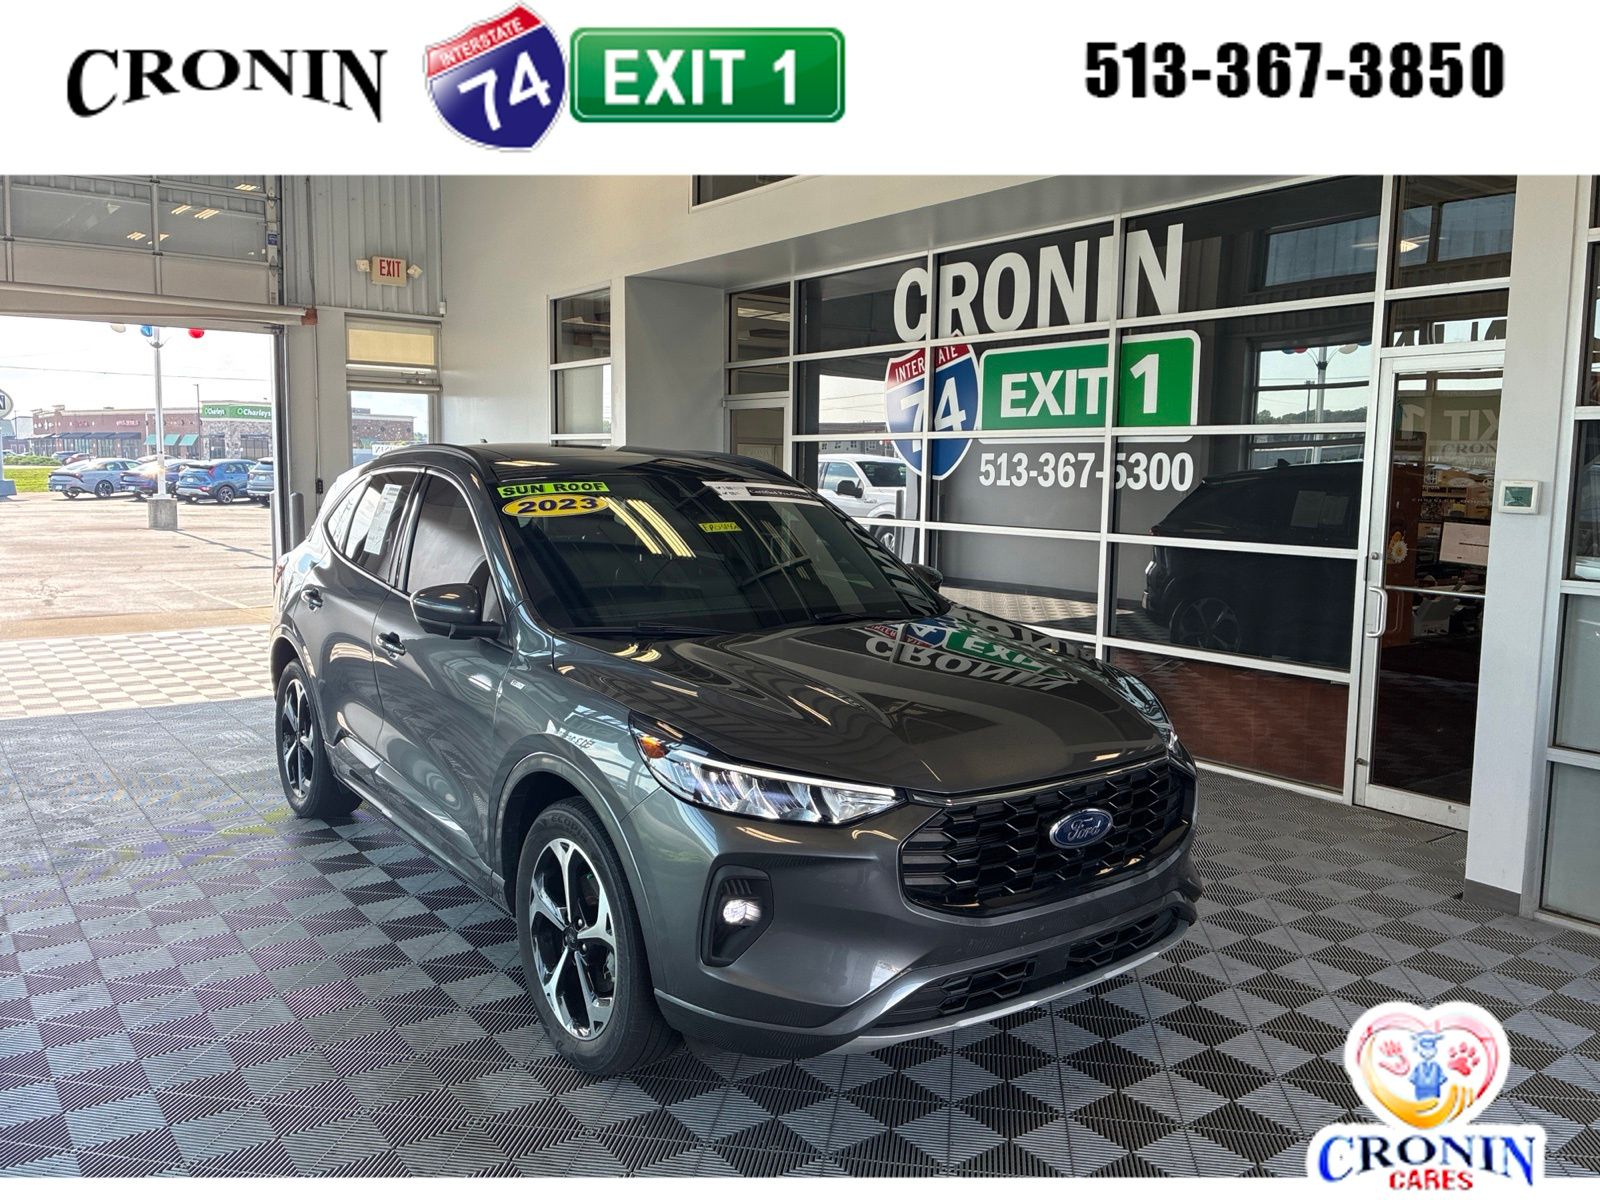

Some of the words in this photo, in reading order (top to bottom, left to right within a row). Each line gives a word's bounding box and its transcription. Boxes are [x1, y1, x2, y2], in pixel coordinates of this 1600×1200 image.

[379, 259, 401, 278] EXIT
[893, 223, 1184, 342] CRONIN
[1000, 366, 1109, 418] EXIT
[1129, 353, 1160, 414] 1
[900, 376, 967, 453] 74
[502, 485, 544, 496] SUN
[553, 483, 604, 493] ROOF
[517, 498, 597, 514] 2023
[1067, 817, 1102, 842] Ford
